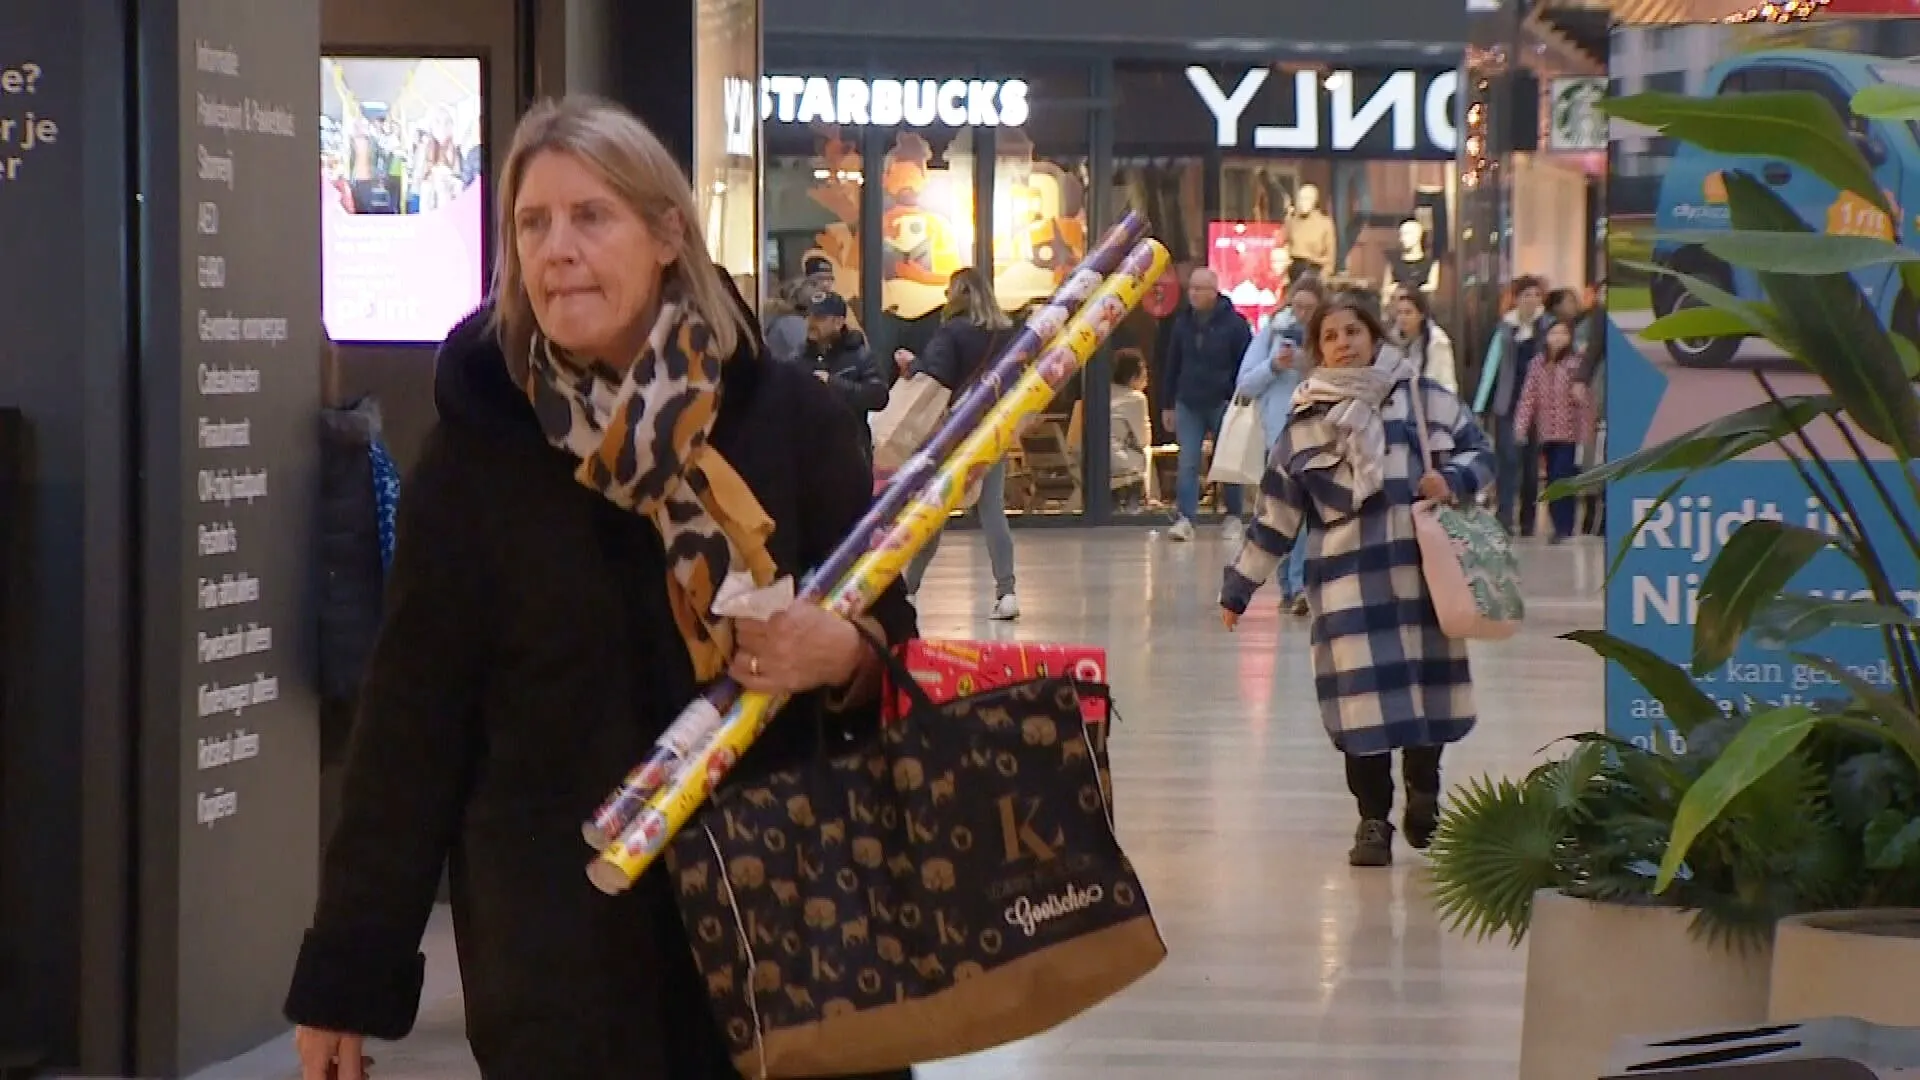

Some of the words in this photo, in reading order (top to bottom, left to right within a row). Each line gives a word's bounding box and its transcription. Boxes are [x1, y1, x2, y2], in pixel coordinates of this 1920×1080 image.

[20, 111, 59, 150] je
[0, 157, 22, 180] r
[198, 201, 219, 234] AED
[198, 256, 226, 288] EHBO
[1726, 657, 1784, 683] kan
[1631, 698, 1672, 719] aa
